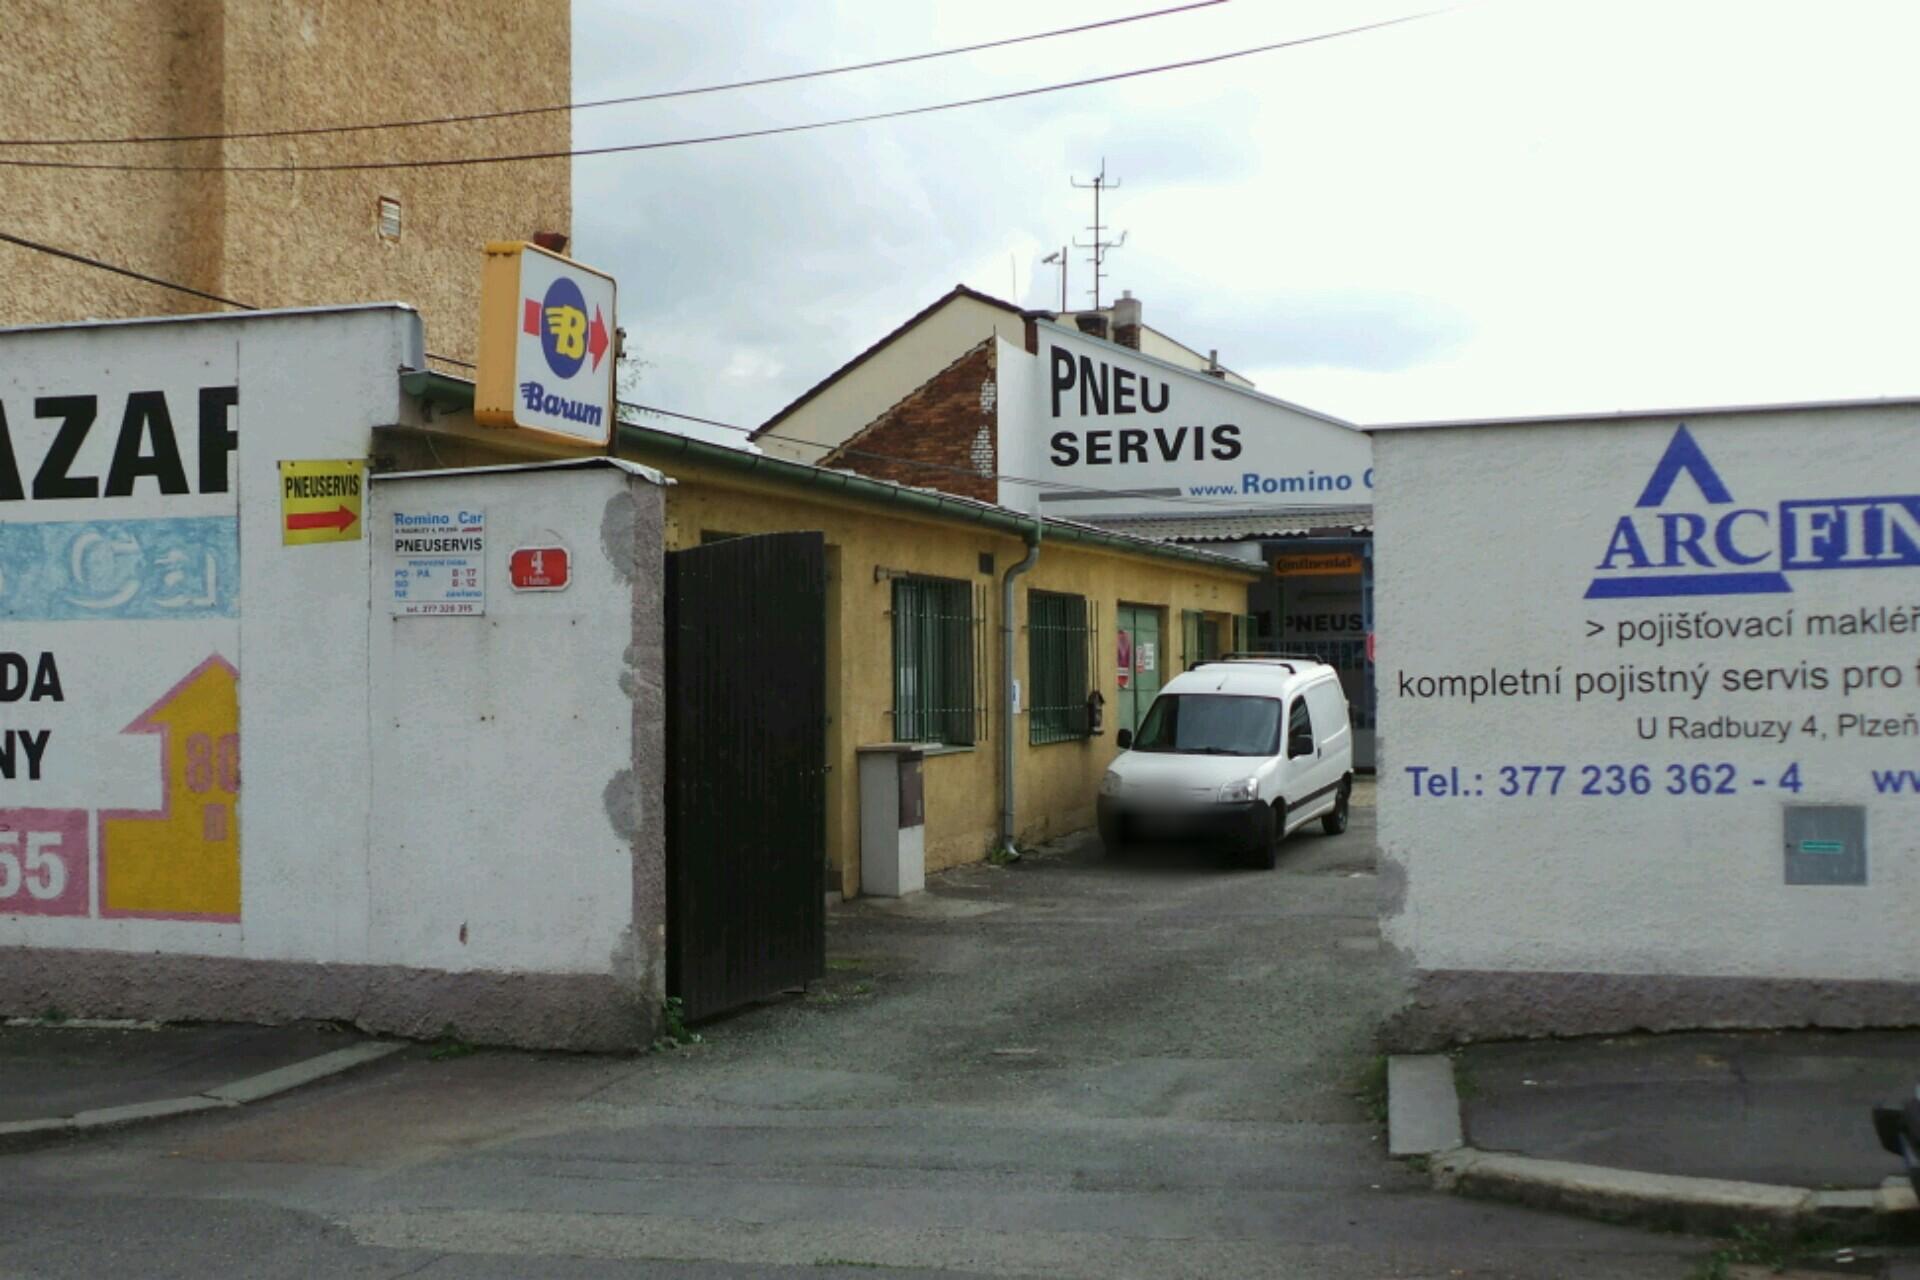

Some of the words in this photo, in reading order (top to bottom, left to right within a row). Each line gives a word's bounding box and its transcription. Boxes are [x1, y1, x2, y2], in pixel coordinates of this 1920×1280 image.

[1051, 345, 1170, 417] PNEU
[520, 381, 602, 426] Barum
[0, 386, 238, 500] ZA
[1050, 424, 1242, 467] SERVIS
[285, 474, 359, 499] PNEUSERVIS
[1242, 471, 1352, 494] Romino
[393, 512, 449, 525] Romino
[458, 511, 482, 524] Car
[394, 537, 482, 552] PNEUSERVIS
[394, 569, 409, 577] PO
[531, 550, 545, 576] 4
[1617, 609, 1794, 648] pojišťovací
[1399, 665, 1562, 703] kompletní
[1575, 661, 1710, 702] pojistný
[1722, 660, 1829, 693] servis
[1843, 664, 1903, 697] pro
[1637, 716, 1657, 740] U
[1669, 716, 1793, 744] Radbuzy
[1801, 715, 1827, 742] 4,
[1838, 712, 1919, 738] Plzeň
[1404, 766, 1484, 797] Tel.:
[1499, 765, 1566, 796] 377
[1581, 764, 1652, 796] 236
[1666, 763, 1737, 795] 362
[1779, 762, 1803, 793] 4
